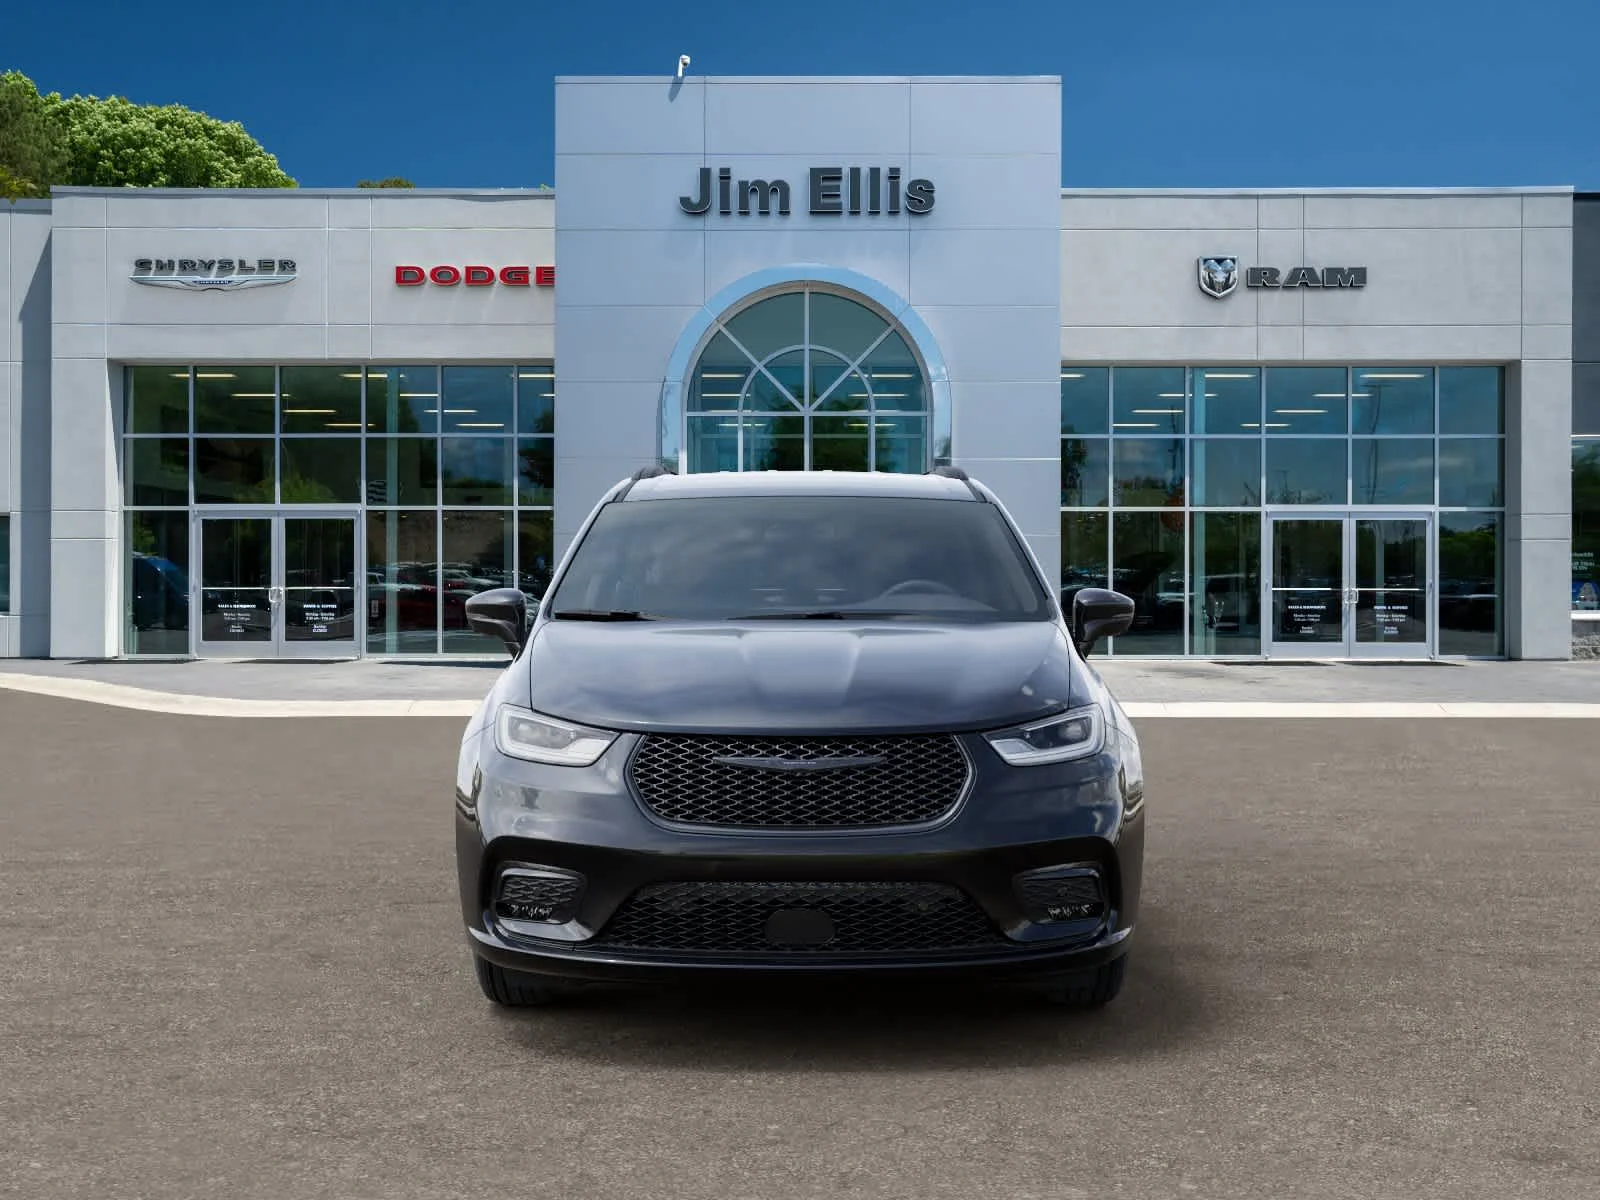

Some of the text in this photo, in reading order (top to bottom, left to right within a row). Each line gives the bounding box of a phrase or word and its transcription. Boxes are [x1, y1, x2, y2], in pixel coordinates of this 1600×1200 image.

[679, 167, 936, 215] Jim Ellis
[134, 258, 297, 272] CHRYSLER
[395, 265, 555, 287] DODGE
[1246, 266, 1368, 289] RAM
